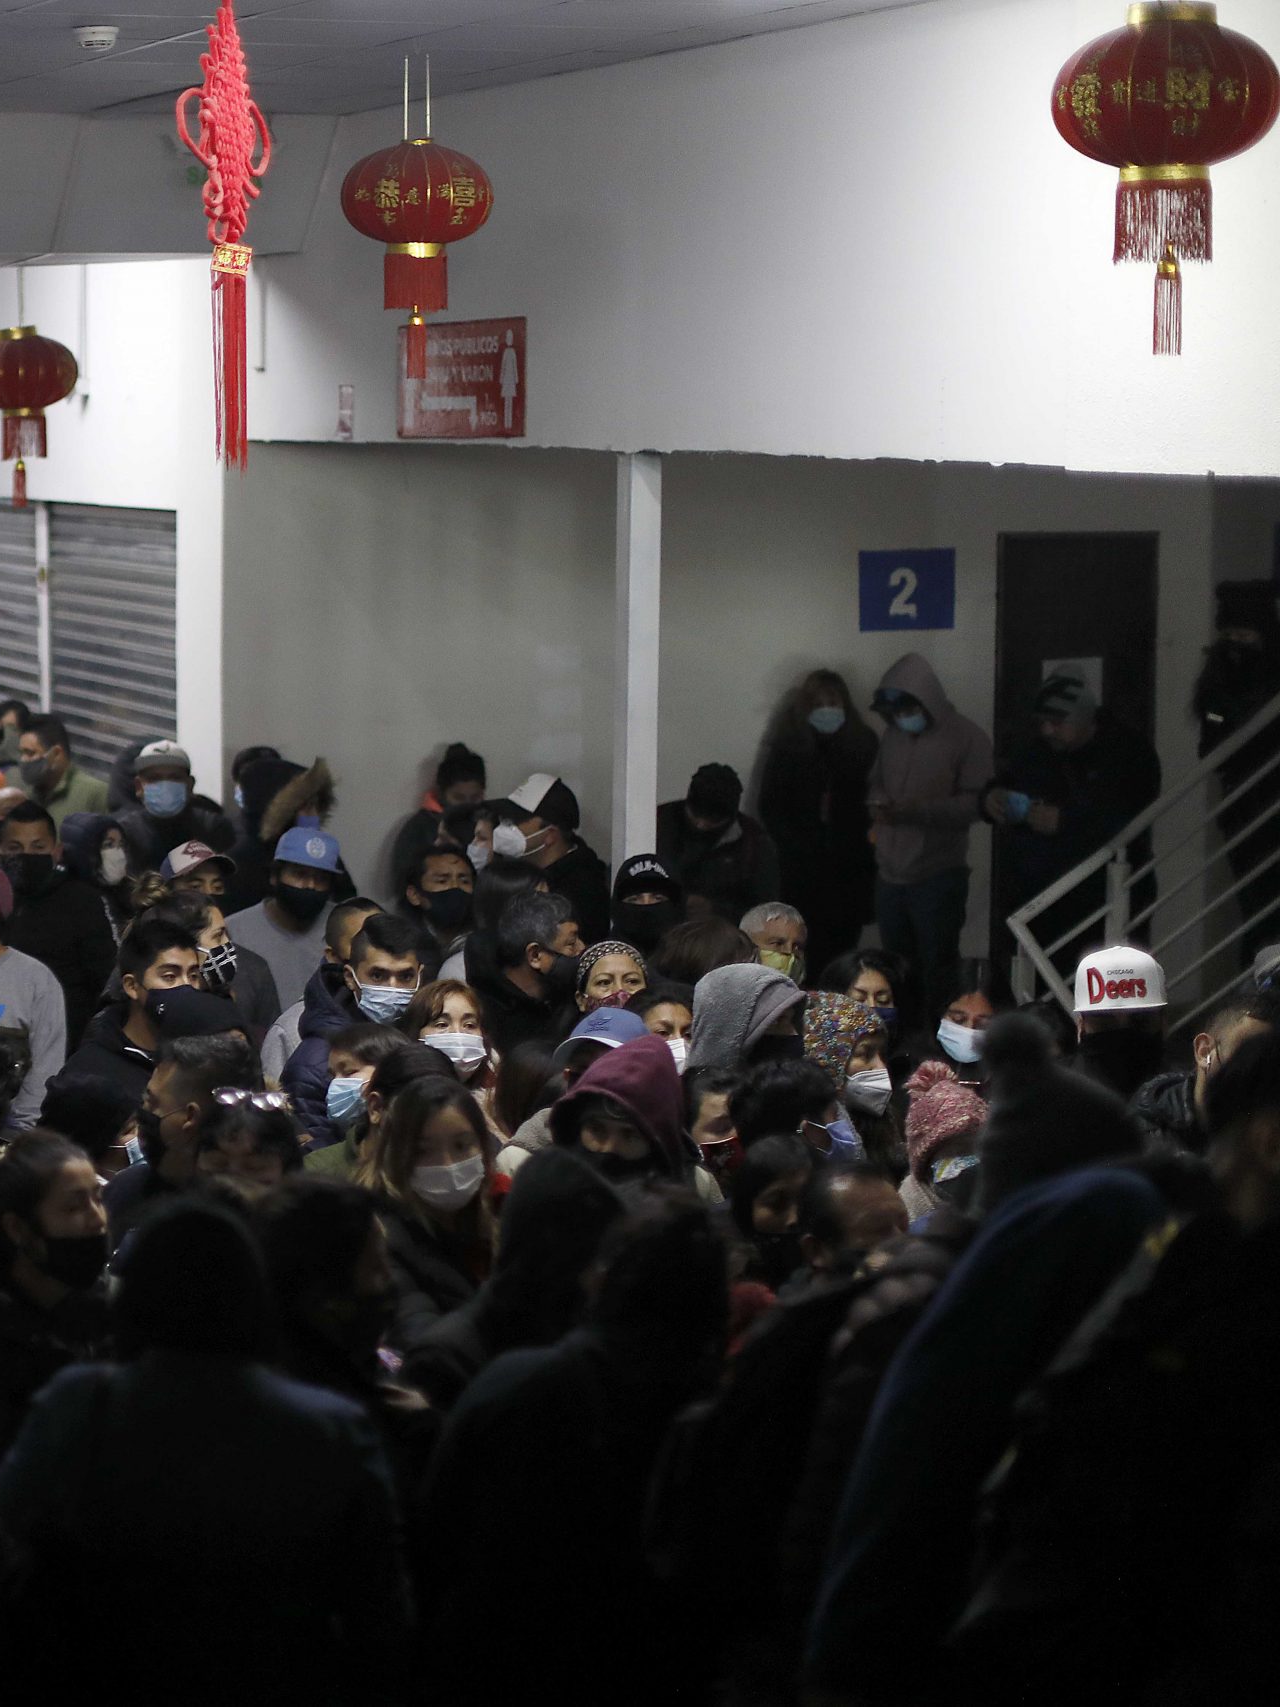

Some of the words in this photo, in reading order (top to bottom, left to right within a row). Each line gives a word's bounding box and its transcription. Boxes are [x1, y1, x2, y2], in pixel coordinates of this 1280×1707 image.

[889, 566, 918, 619] 2
[1087, 967, 1147, 1004] Deers
[1107, 968, 1134, 976] CHICAGO
